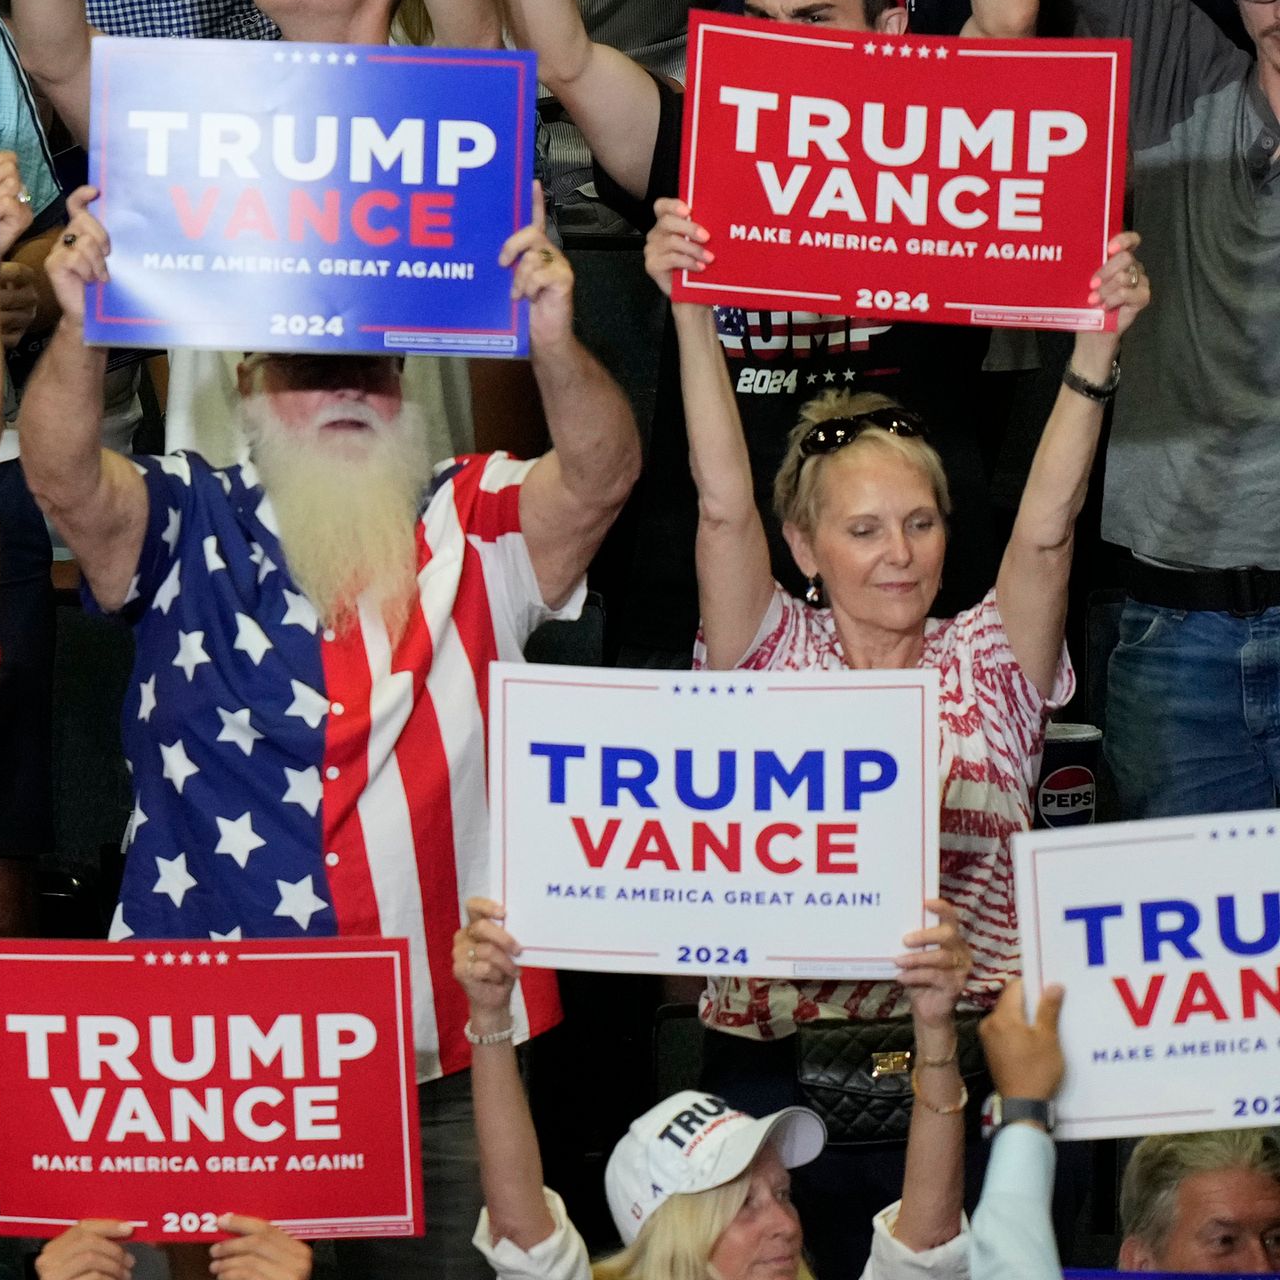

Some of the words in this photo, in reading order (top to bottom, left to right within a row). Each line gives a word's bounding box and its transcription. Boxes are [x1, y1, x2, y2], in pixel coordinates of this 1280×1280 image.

[126, 110, 498, 188] TRUMP
[720, 86, 1087, 172] TRUMP
[168, 185, 454, 249] VANCE
[756, 161, 1044, 231] VANCE
[730, 224, 791, 244] MAKE
[799, 231, 898, 252] AMERICA
[906, 239, 977, 257] GREAT
[985, 243, 1062, 261] AGAIN!
[269, 314, 345, 338] 2024
[856, 289, 929, 312] 2024
[735, 367, 799, 395] 2024
[530, 743, 897, 811] TRUMP
[572, 817, 858, 874] VANCE
[548, 885, 604, 899] MAKE
[616, 888, 713, 903] AMERICA
[724, 891, 793, 904] GREAT
[805, 893, 880, 905] AGAIN!
[678, 947, 748, 964] 2024
[6, 1013, 377, 1081] TRUMP
[51, 1086, 340, 1142] VANCE
[33, 1155, 92, 1172] MAKE
[100, 1157, 199, 1172] AMERICA
[206, 1156, 278, 1172] GREAT
[286, 1154, 363, 1171] AGAIN!
